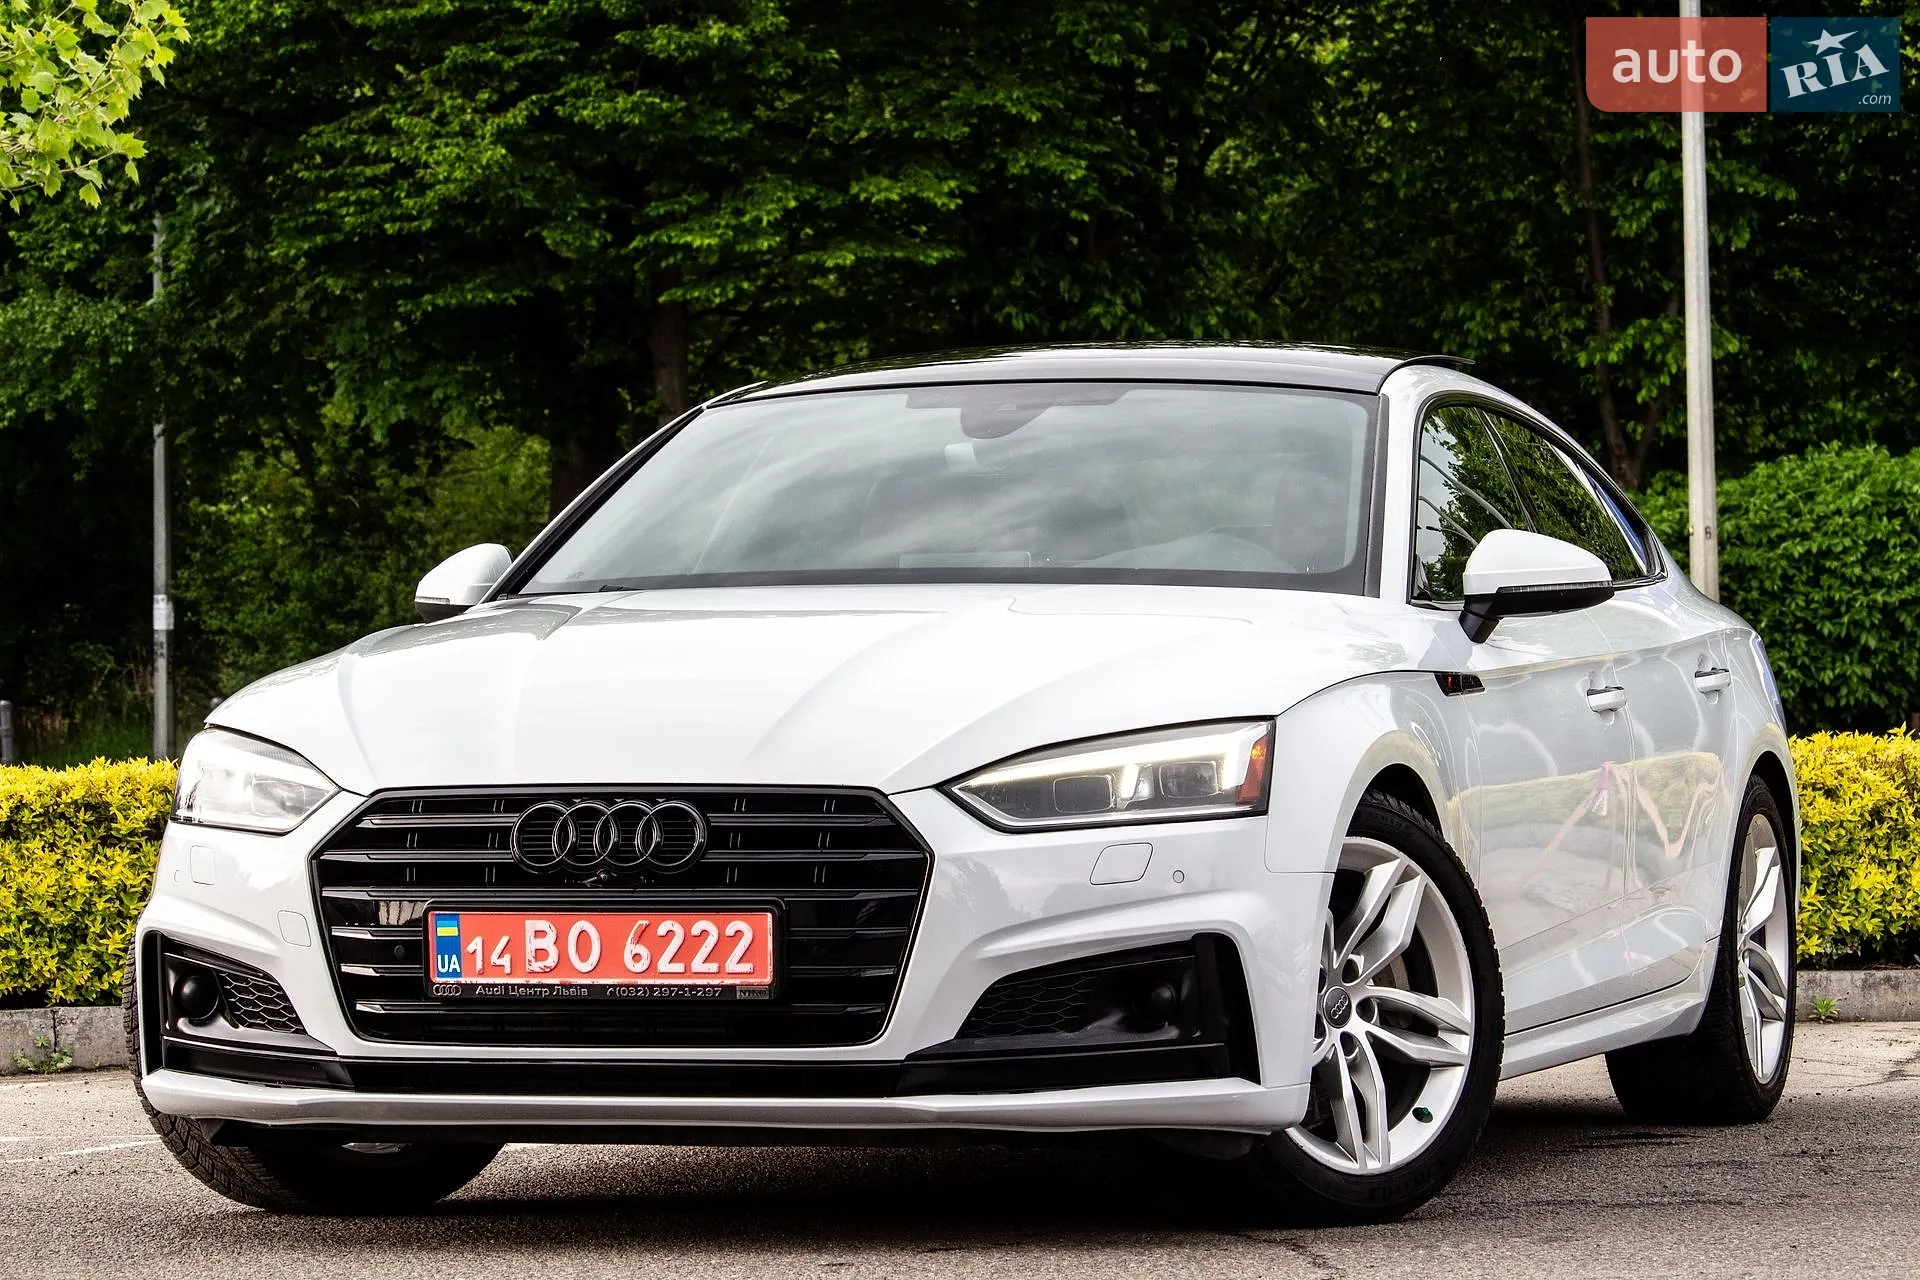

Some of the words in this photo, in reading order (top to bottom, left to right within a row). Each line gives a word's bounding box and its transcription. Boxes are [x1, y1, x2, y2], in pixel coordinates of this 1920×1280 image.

[466, 936, 512, 975] 14
[525, 919, 601, 974] BO
[623, 919, 754, 974] 6222
[437, 954, 460, 973] UA
[475, 985, 505, 996] Audi
[508, 985, 550, 997] Центр
[552, 985, 588, 996] Львів
[615, 986, 650, 997] (032)
[653, 987, 722, 997] 297-1-297
